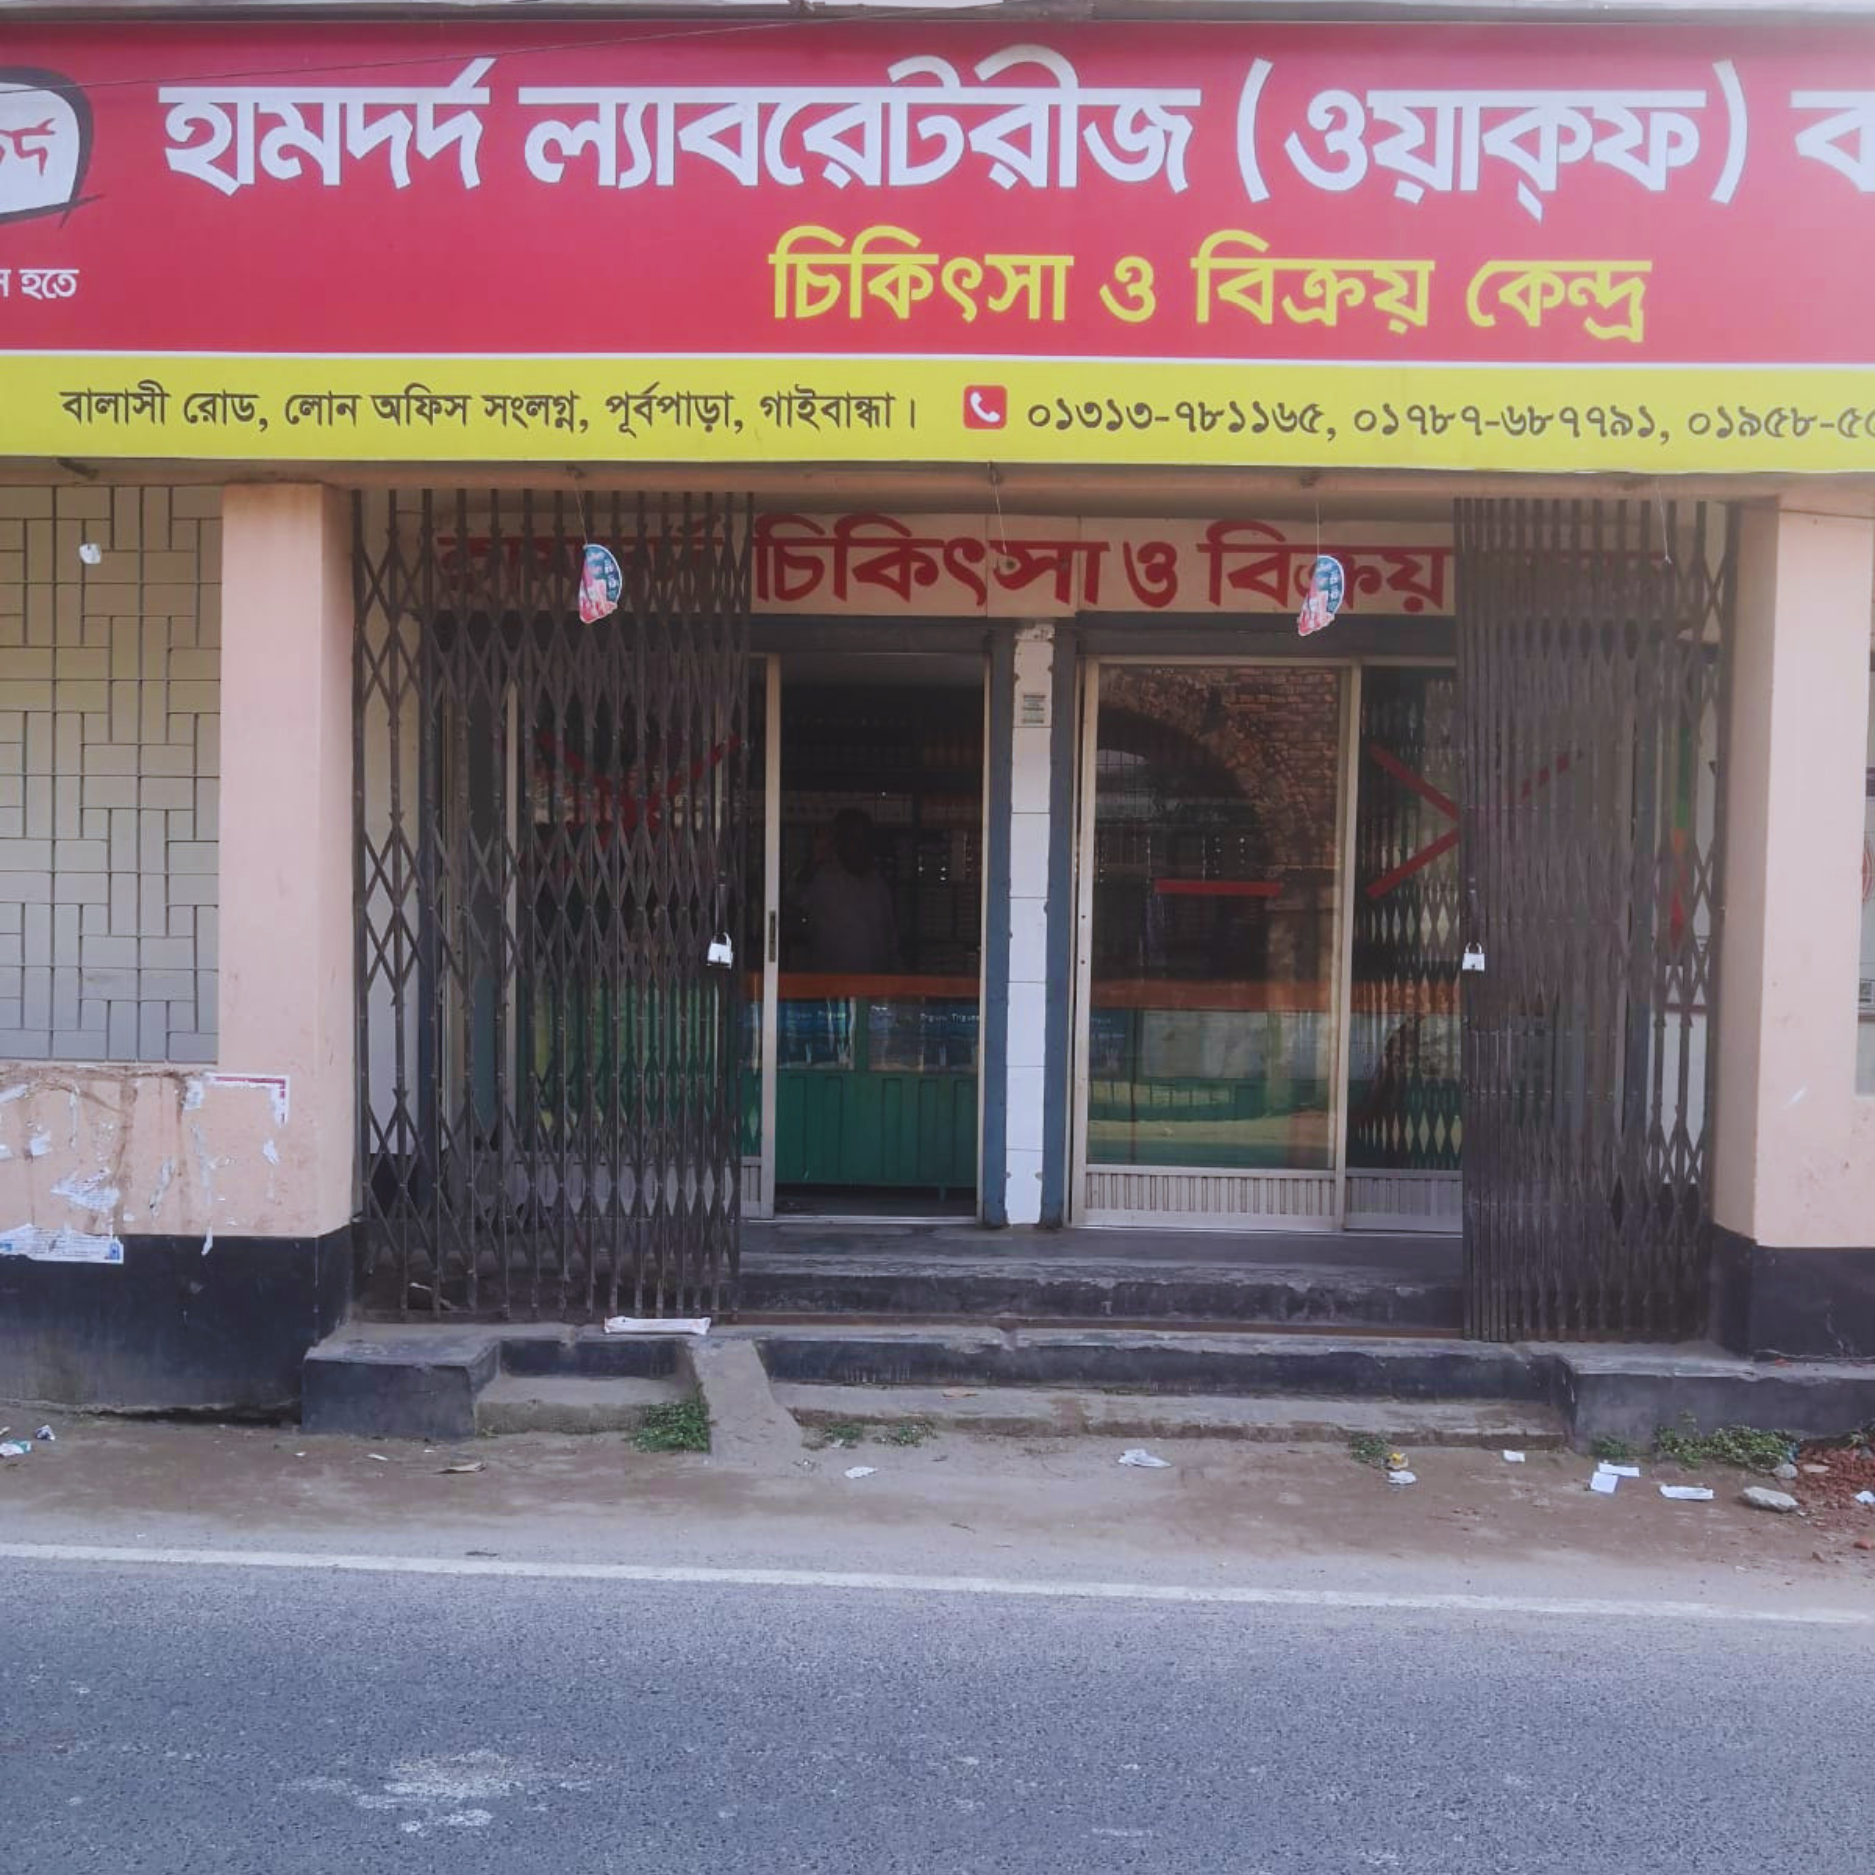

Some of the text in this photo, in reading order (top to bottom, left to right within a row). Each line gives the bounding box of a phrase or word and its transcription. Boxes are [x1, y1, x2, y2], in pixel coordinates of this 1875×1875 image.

[159, 59, 495, 195] হামদর্দ
[519, 43, 1201, 193] ল্যাবরেটরীজ
[20, 270, 79, 299] হতে
[768, 226, 1653, 343] চিকিৎসা ও বিক্রয় কেন্দ্র
[60, 379, 171, 425] বালাসী
[184, 390, 267, 432] রোড,
[285, 391, 362, 426] লোন
[370, 383, 472, 426] অফিস
[482, 390, 588, 433] সংলগ্ন,
[606, 382, 742, 438] পূর্বপাড়া,
[1028, 398, 1335, 440] ০১৩১৩-৭৮১১৬৫,
[1355, 404, 1668, 443] ০১৭৮৭-৬৮৭৭৯১,
[752, 513, 1112, 608] চিকিৎসা
[1122, 540, 1182, 610] ও
